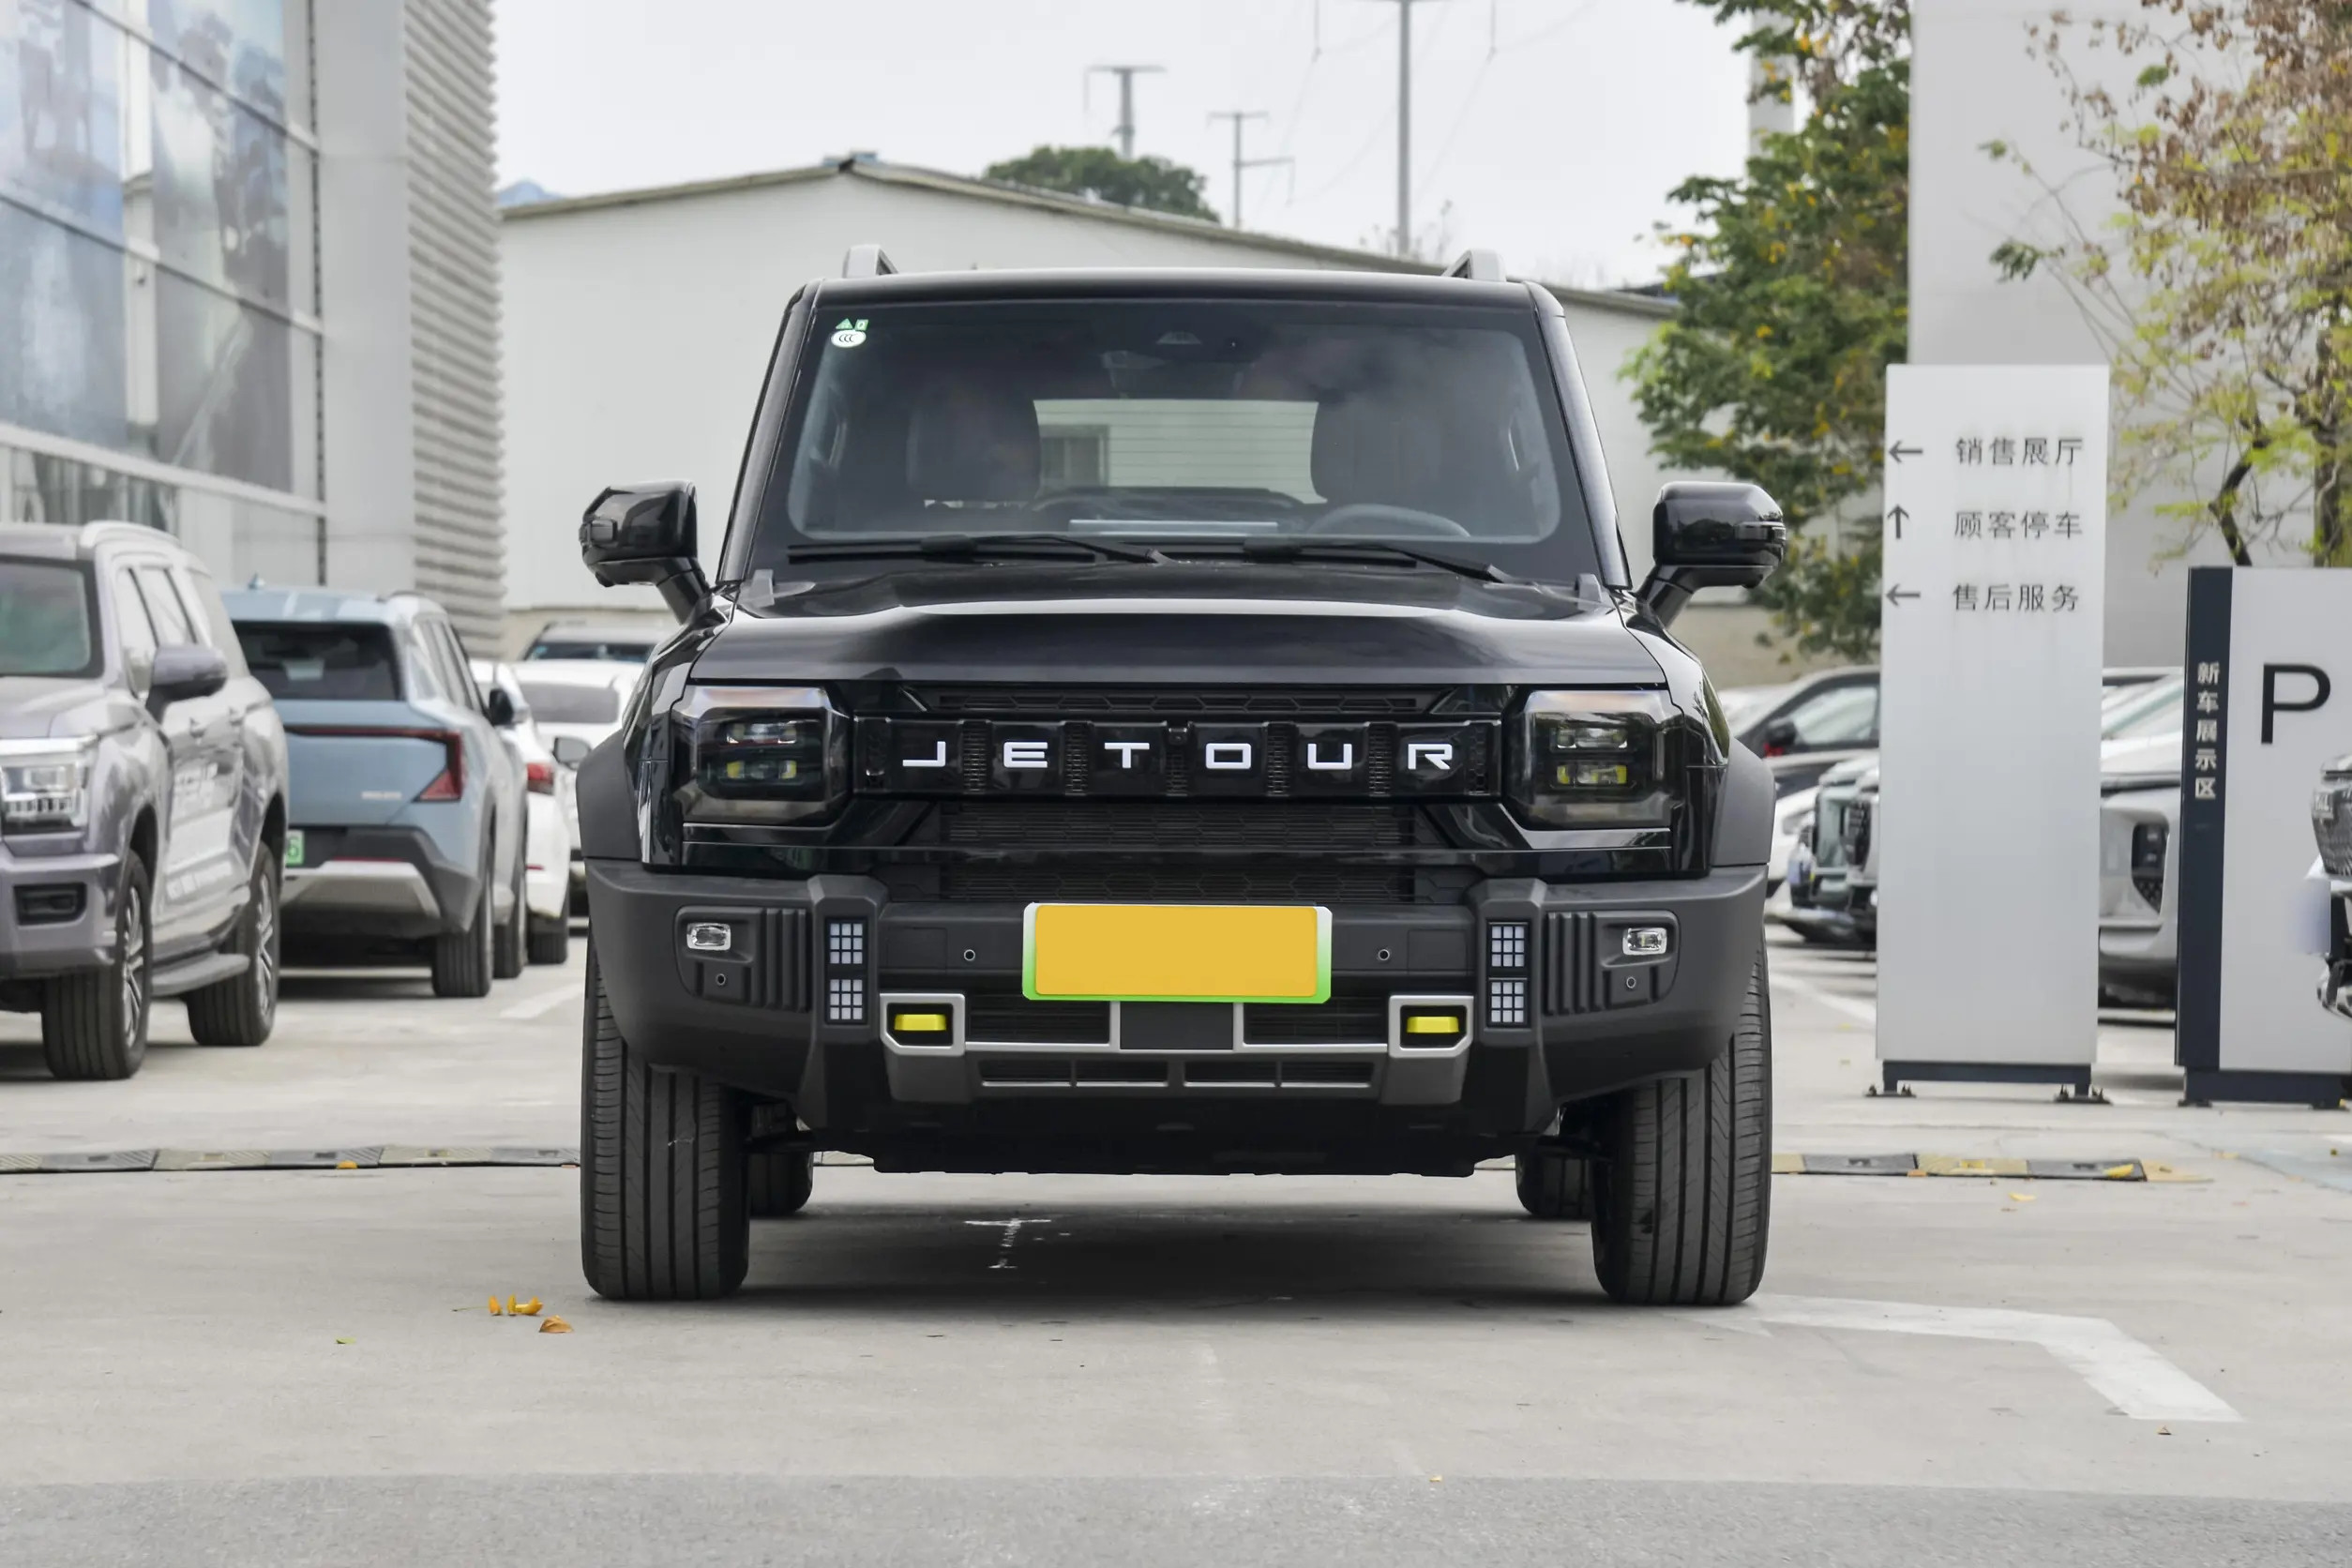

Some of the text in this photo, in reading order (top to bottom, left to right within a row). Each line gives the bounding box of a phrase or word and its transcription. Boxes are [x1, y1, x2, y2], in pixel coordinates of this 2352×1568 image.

[1955, 437, 2083, 466] 销售展厅
[1954, 510, 2083, 539] 顾客停车
[1952, 582, 2079, 612] 售后服务
[2261, 663, 2331, 745] P
[2195, 661, 2220, 799] 新车展示区
[902, 741, 1453, 770] JETOUR
